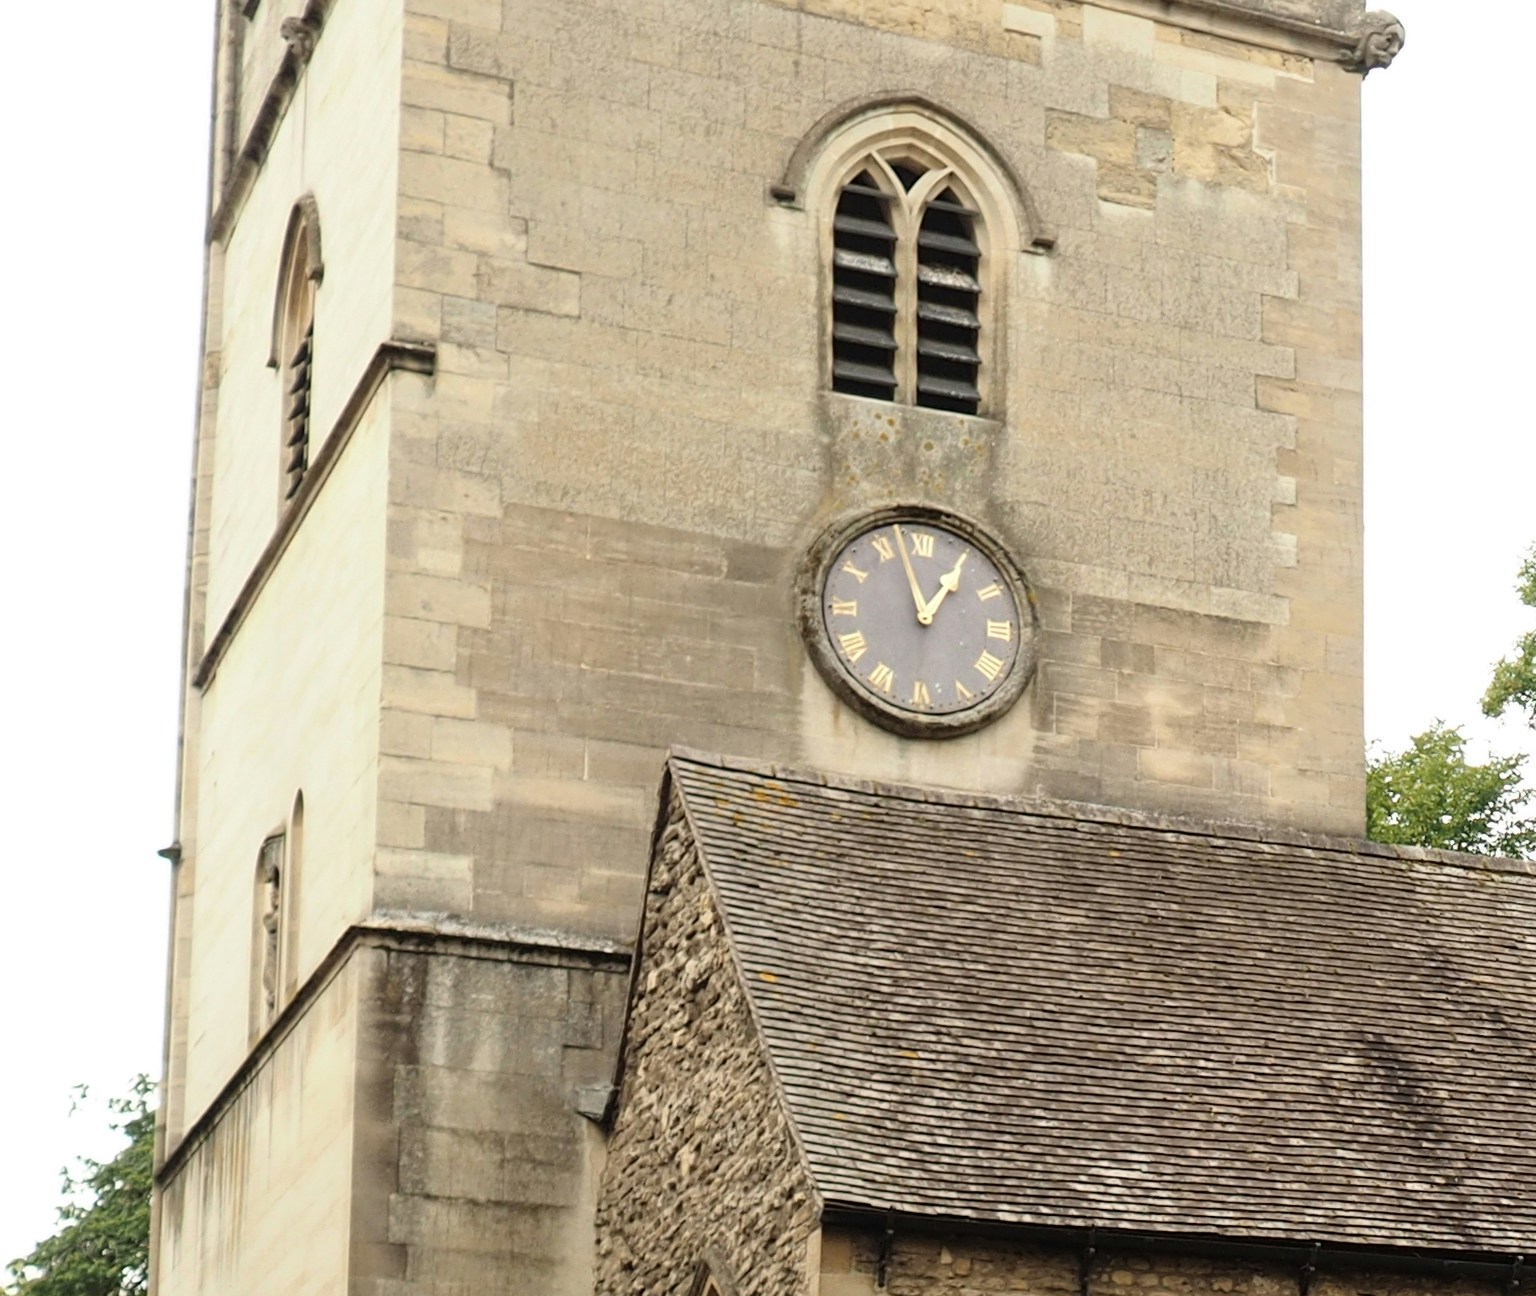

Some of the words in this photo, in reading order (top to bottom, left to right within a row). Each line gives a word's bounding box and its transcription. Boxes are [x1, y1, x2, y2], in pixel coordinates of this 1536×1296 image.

[872, 534, 896, 562] XI
[910, 532, 934, 557] XII
[842, 560, 869, 584] X
[832, 595, 857, 616] IX
[976, 584, 1003, 602] II
[986, 619, 1010, 642] III
[838, 630, 868, 663] VIII
[867, 661, 893, 694] VII
[974, 649, 1004, 681] IIII
[913, 681, 931, 708] VI
[954, 680, 973, 704] V
